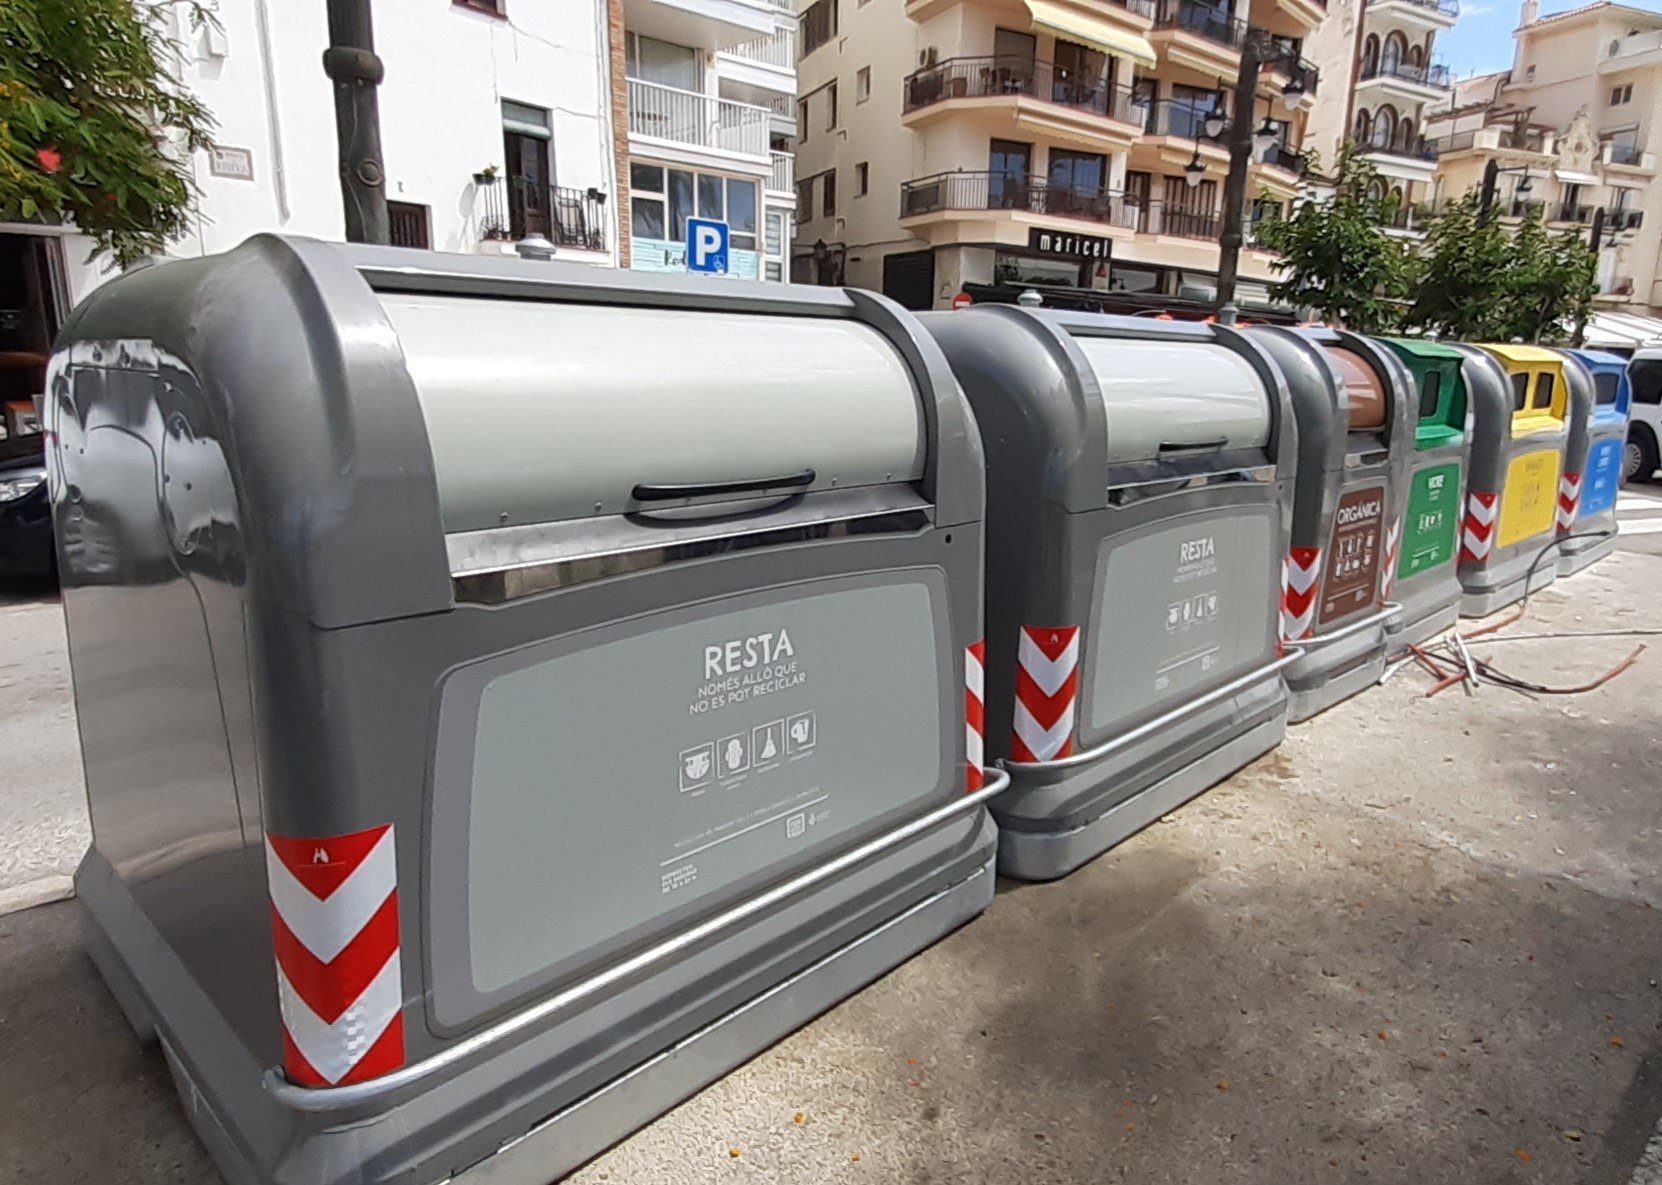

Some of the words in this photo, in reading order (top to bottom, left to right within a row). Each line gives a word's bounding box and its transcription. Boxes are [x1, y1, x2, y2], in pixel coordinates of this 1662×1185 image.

[696, 225, 722, 266] P
[1040, 235, 1108, 257] maricel
[1180, 537, 1215, 563] RESTA
[705, 628, 794, 680] RESTA
[742, 667, 773, 686] ALLÒ
[774, 661, 798, 678] QUE
[689, 700, 708, 715] NO
[711, 695, 725, 709] ES
[728, 688, 750, 704] POT
[753, 672, 806, 698] RECICLAR
